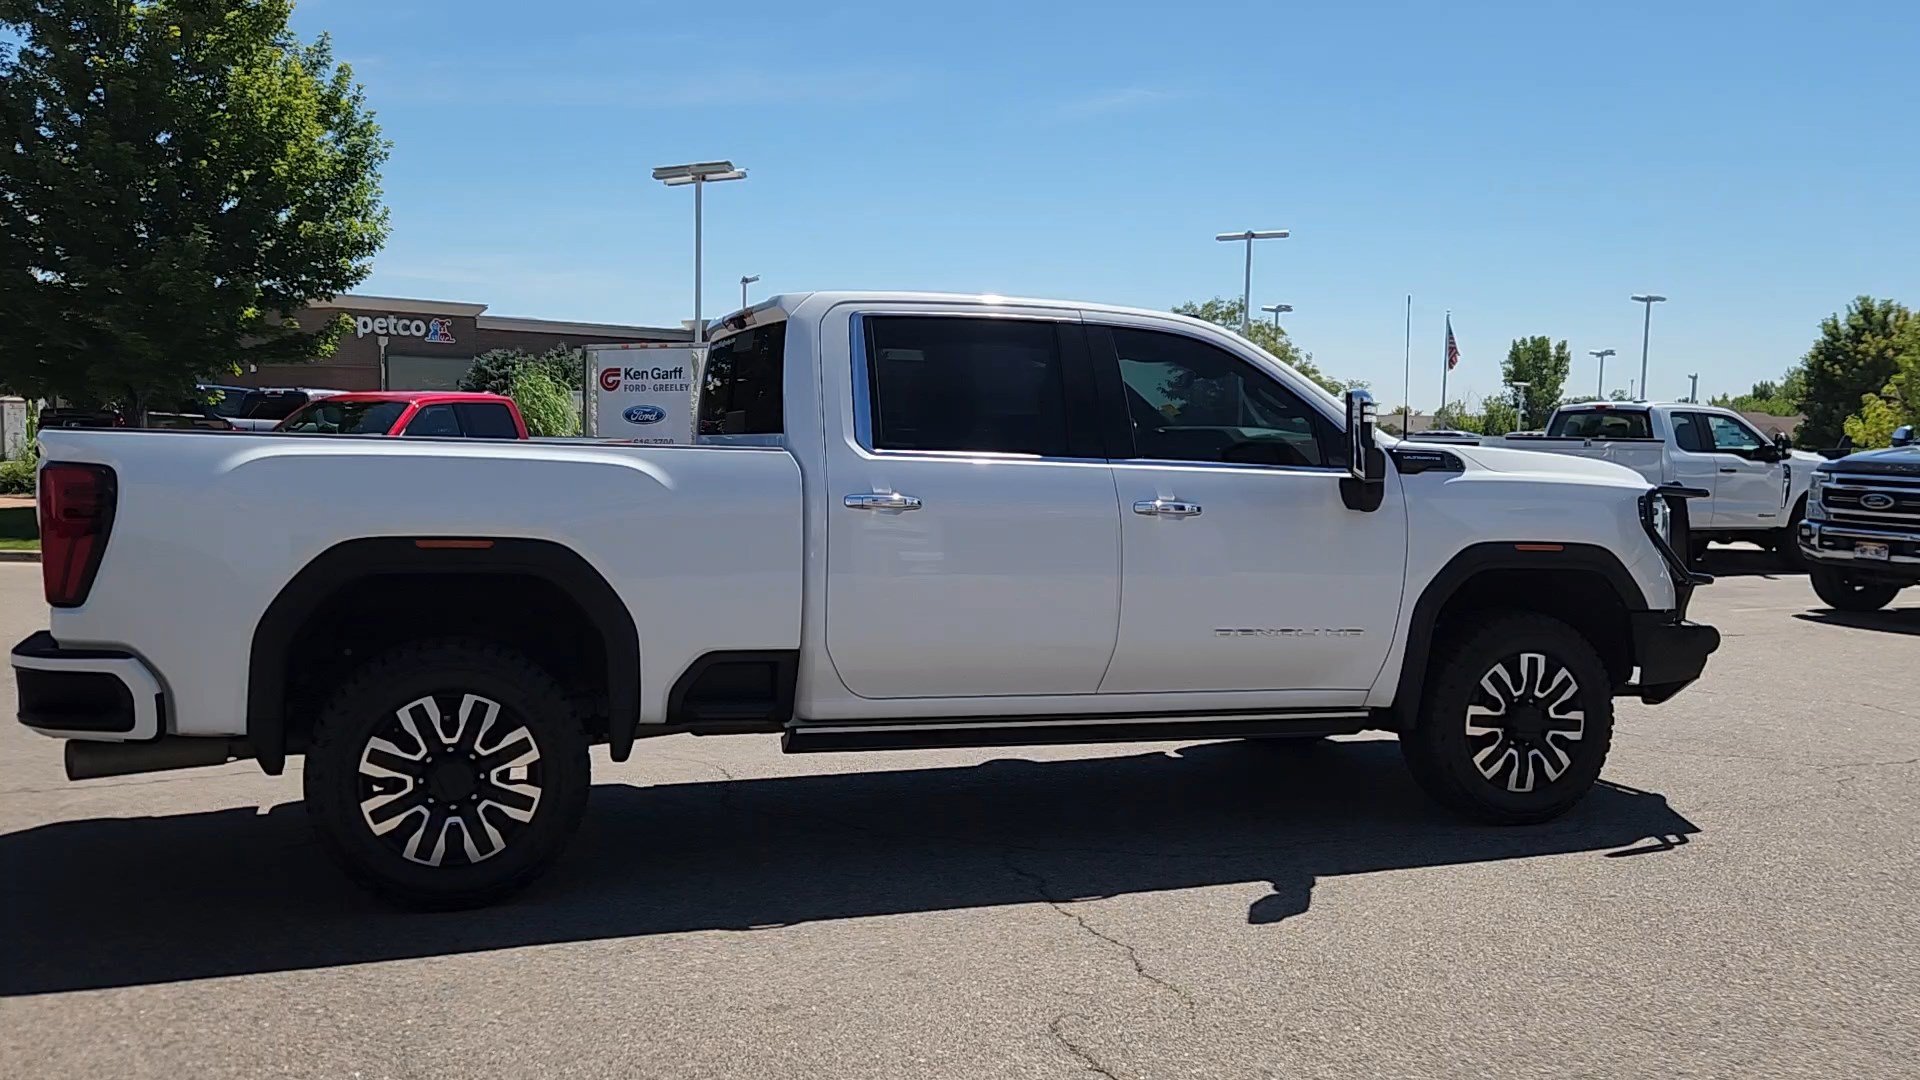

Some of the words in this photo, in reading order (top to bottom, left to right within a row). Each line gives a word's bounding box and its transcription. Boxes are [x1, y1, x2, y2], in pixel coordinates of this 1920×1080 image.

[356, 314, 427, 339] petco
[624, 367, 648, 380] Ken
[650, 366, 684, 380] Garff
[624, 384, 647, 392] FORD
[652, 383, 690, 392] GREELEY
[630, 408, 658, 421] Ford
